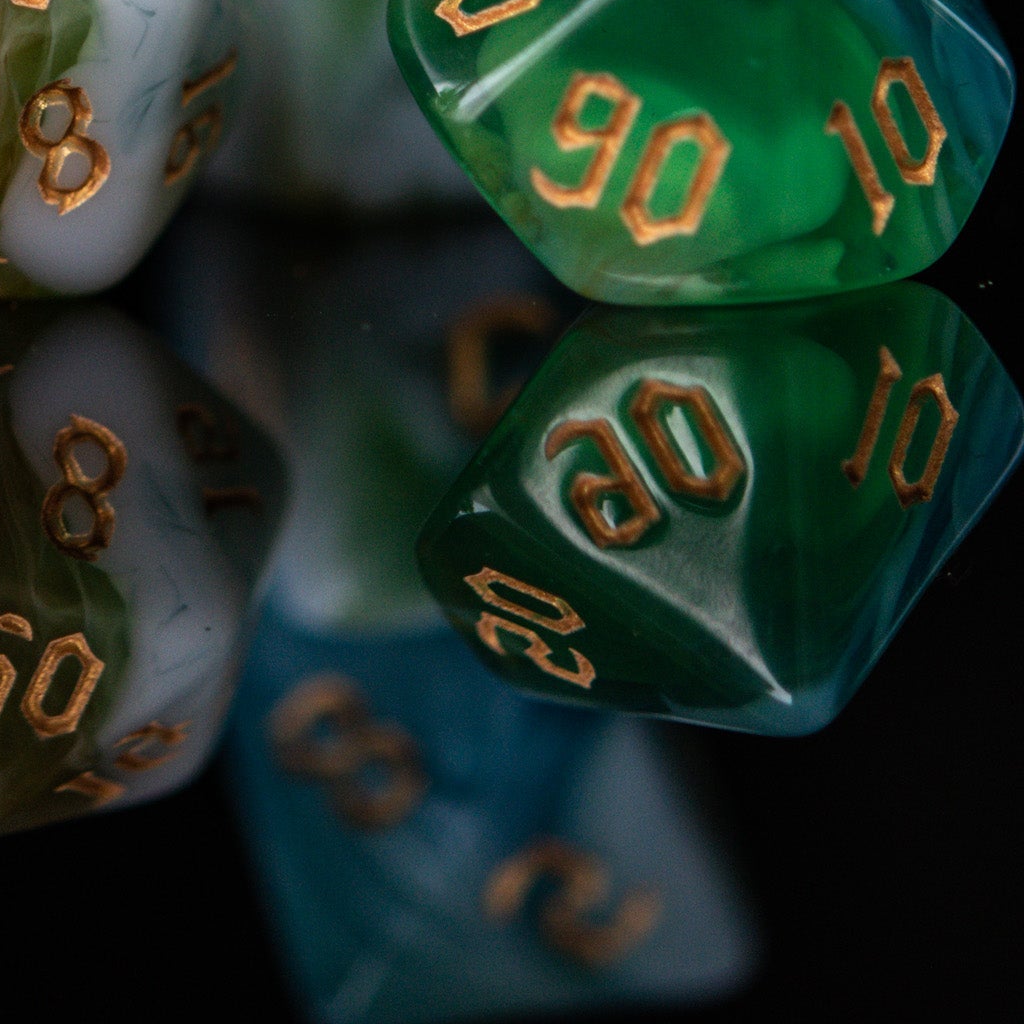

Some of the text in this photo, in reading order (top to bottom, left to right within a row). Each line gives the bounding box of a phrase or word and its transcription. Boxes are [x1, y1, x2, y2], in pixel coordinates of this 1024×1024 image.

[18, 78, 111, 216] 8
[530, 69, 733, 247] 90
[823, 56, 947, 237] 10
